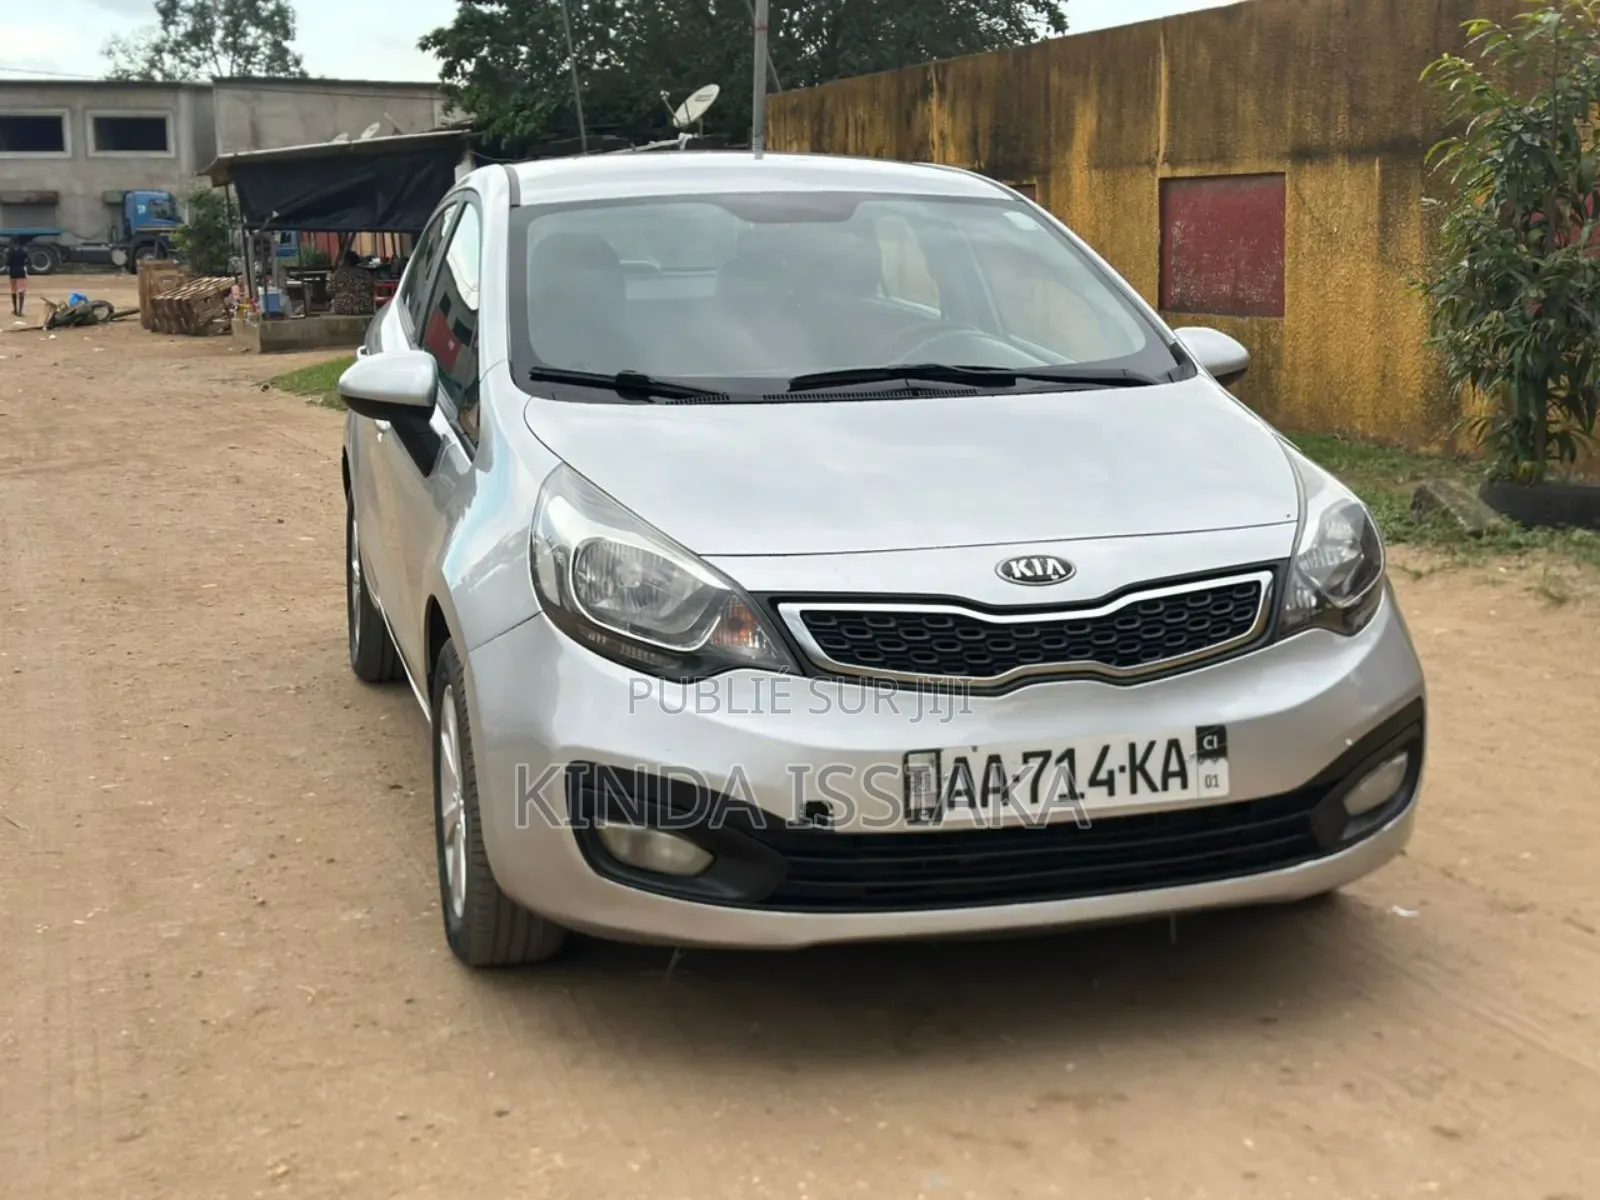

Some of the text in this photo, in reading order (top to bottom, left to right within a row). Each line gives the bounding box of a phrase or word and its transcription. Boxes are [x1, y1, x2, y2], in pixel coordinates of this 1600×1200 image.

[1009, 558, 1066, 578] KIA
[1203, 734, 1218, 750] CI
[1204, 773, 1220, 789] 01
